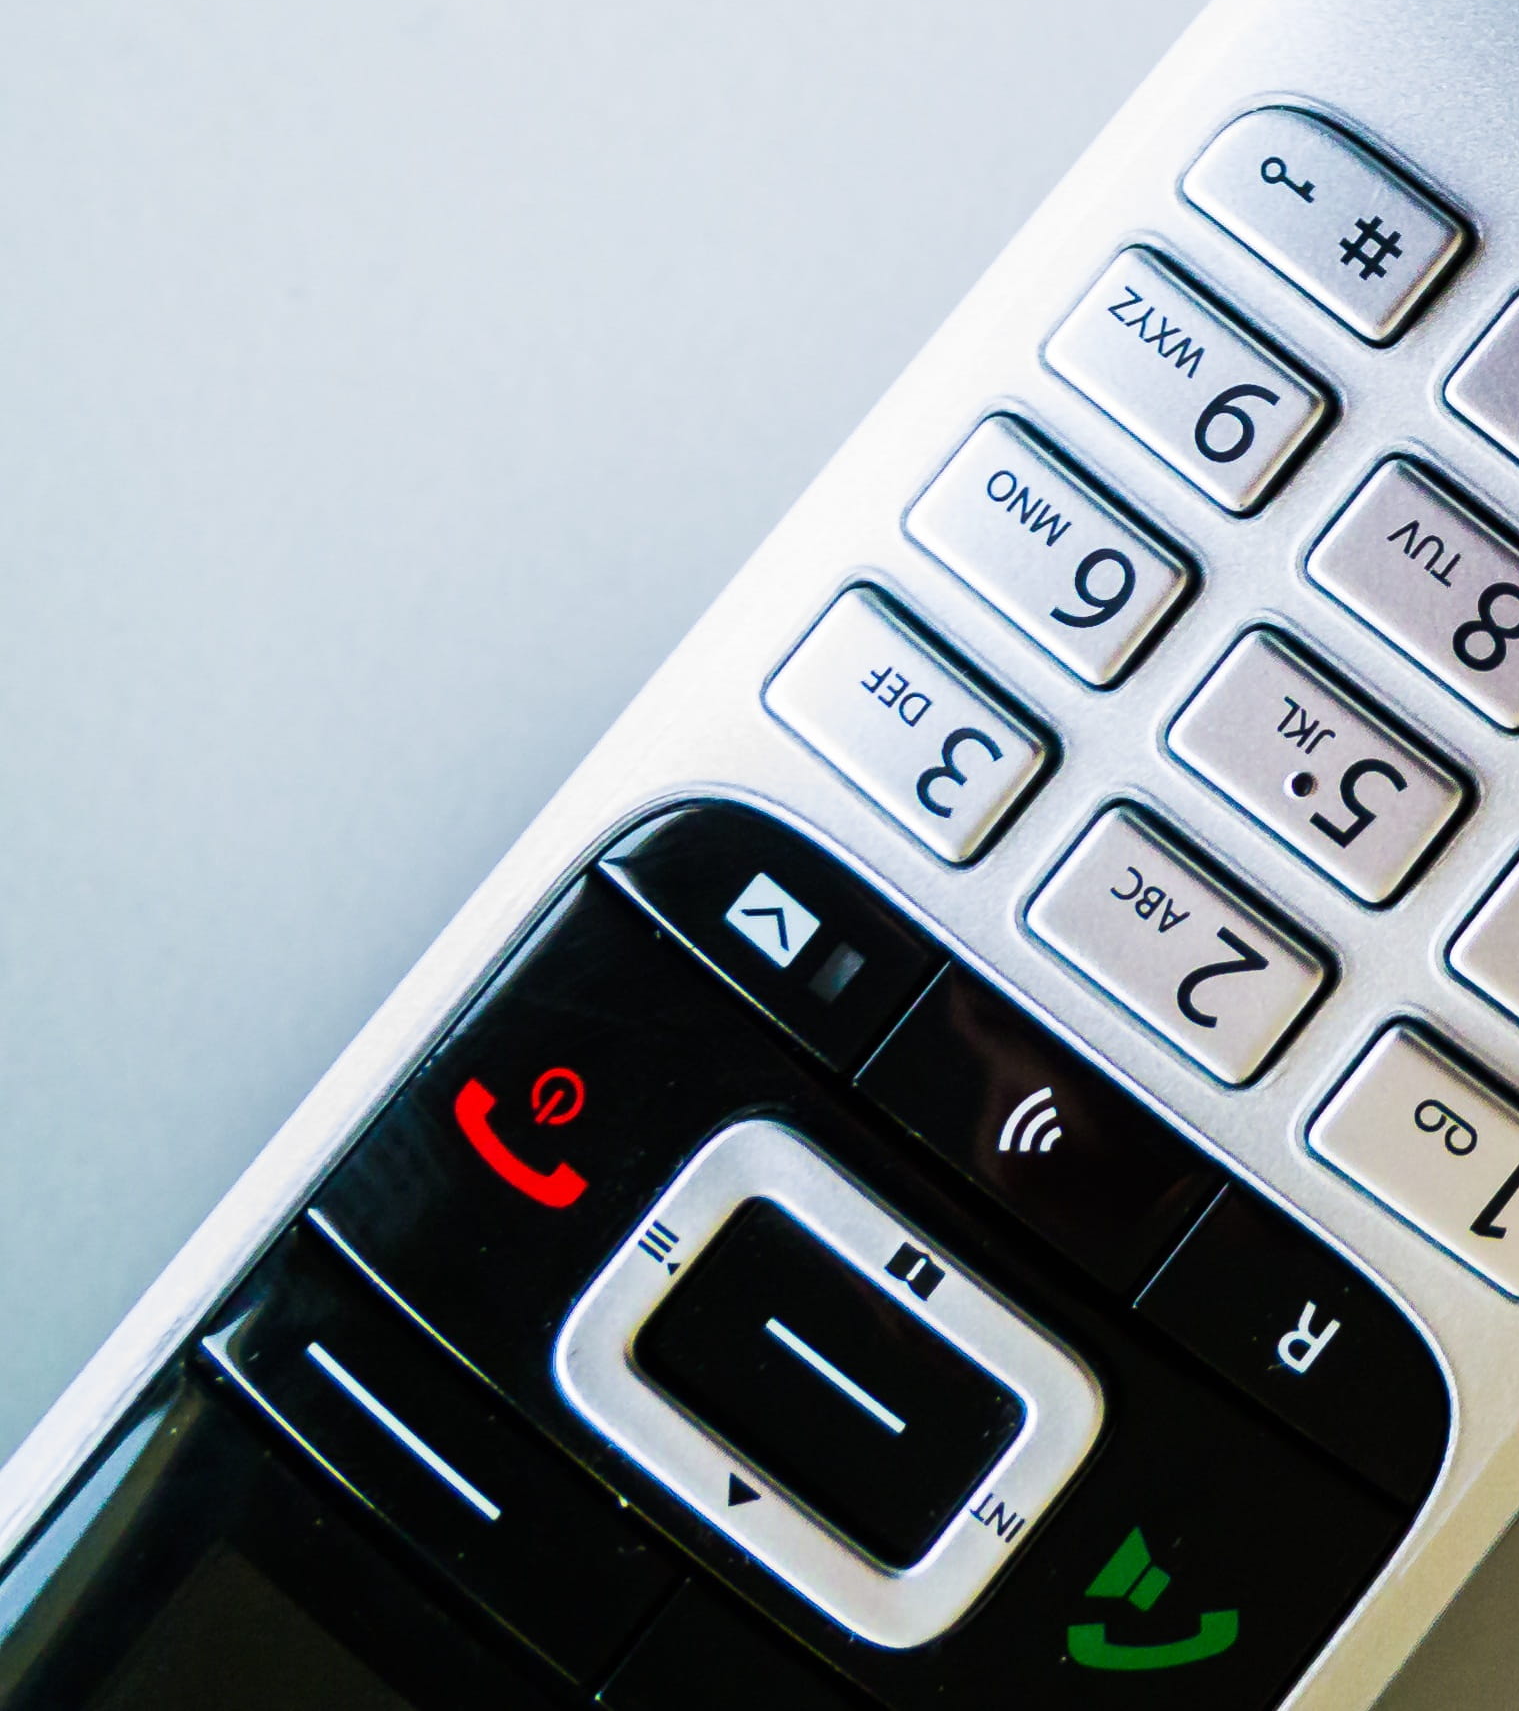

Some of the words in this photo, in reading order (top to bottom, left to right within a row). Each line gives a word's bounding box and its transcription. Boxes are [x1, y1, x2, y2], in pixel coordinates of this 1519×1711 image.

[1108, 288, 1204, 378] WXYZ
[1195, 384, 1279, 463] 9
[987, 471, 1071, 546] MNO
[1050, 549, 1135, 628] 6
[1388, 521, 1460, 587] TUV
[862, 668, 932, 727] DEF
[1278, 697, 1335, 754] JKL
[917, 728, 1002, 818] 3
[1310, 759, 1407, 848] 5
[1111, 867, 1190, 932] ABC
[1177, 927, 1268, 1028] 2
[1278, 1302, 1340, 1373] R
[971, 1494, 1024, 1542] INT
